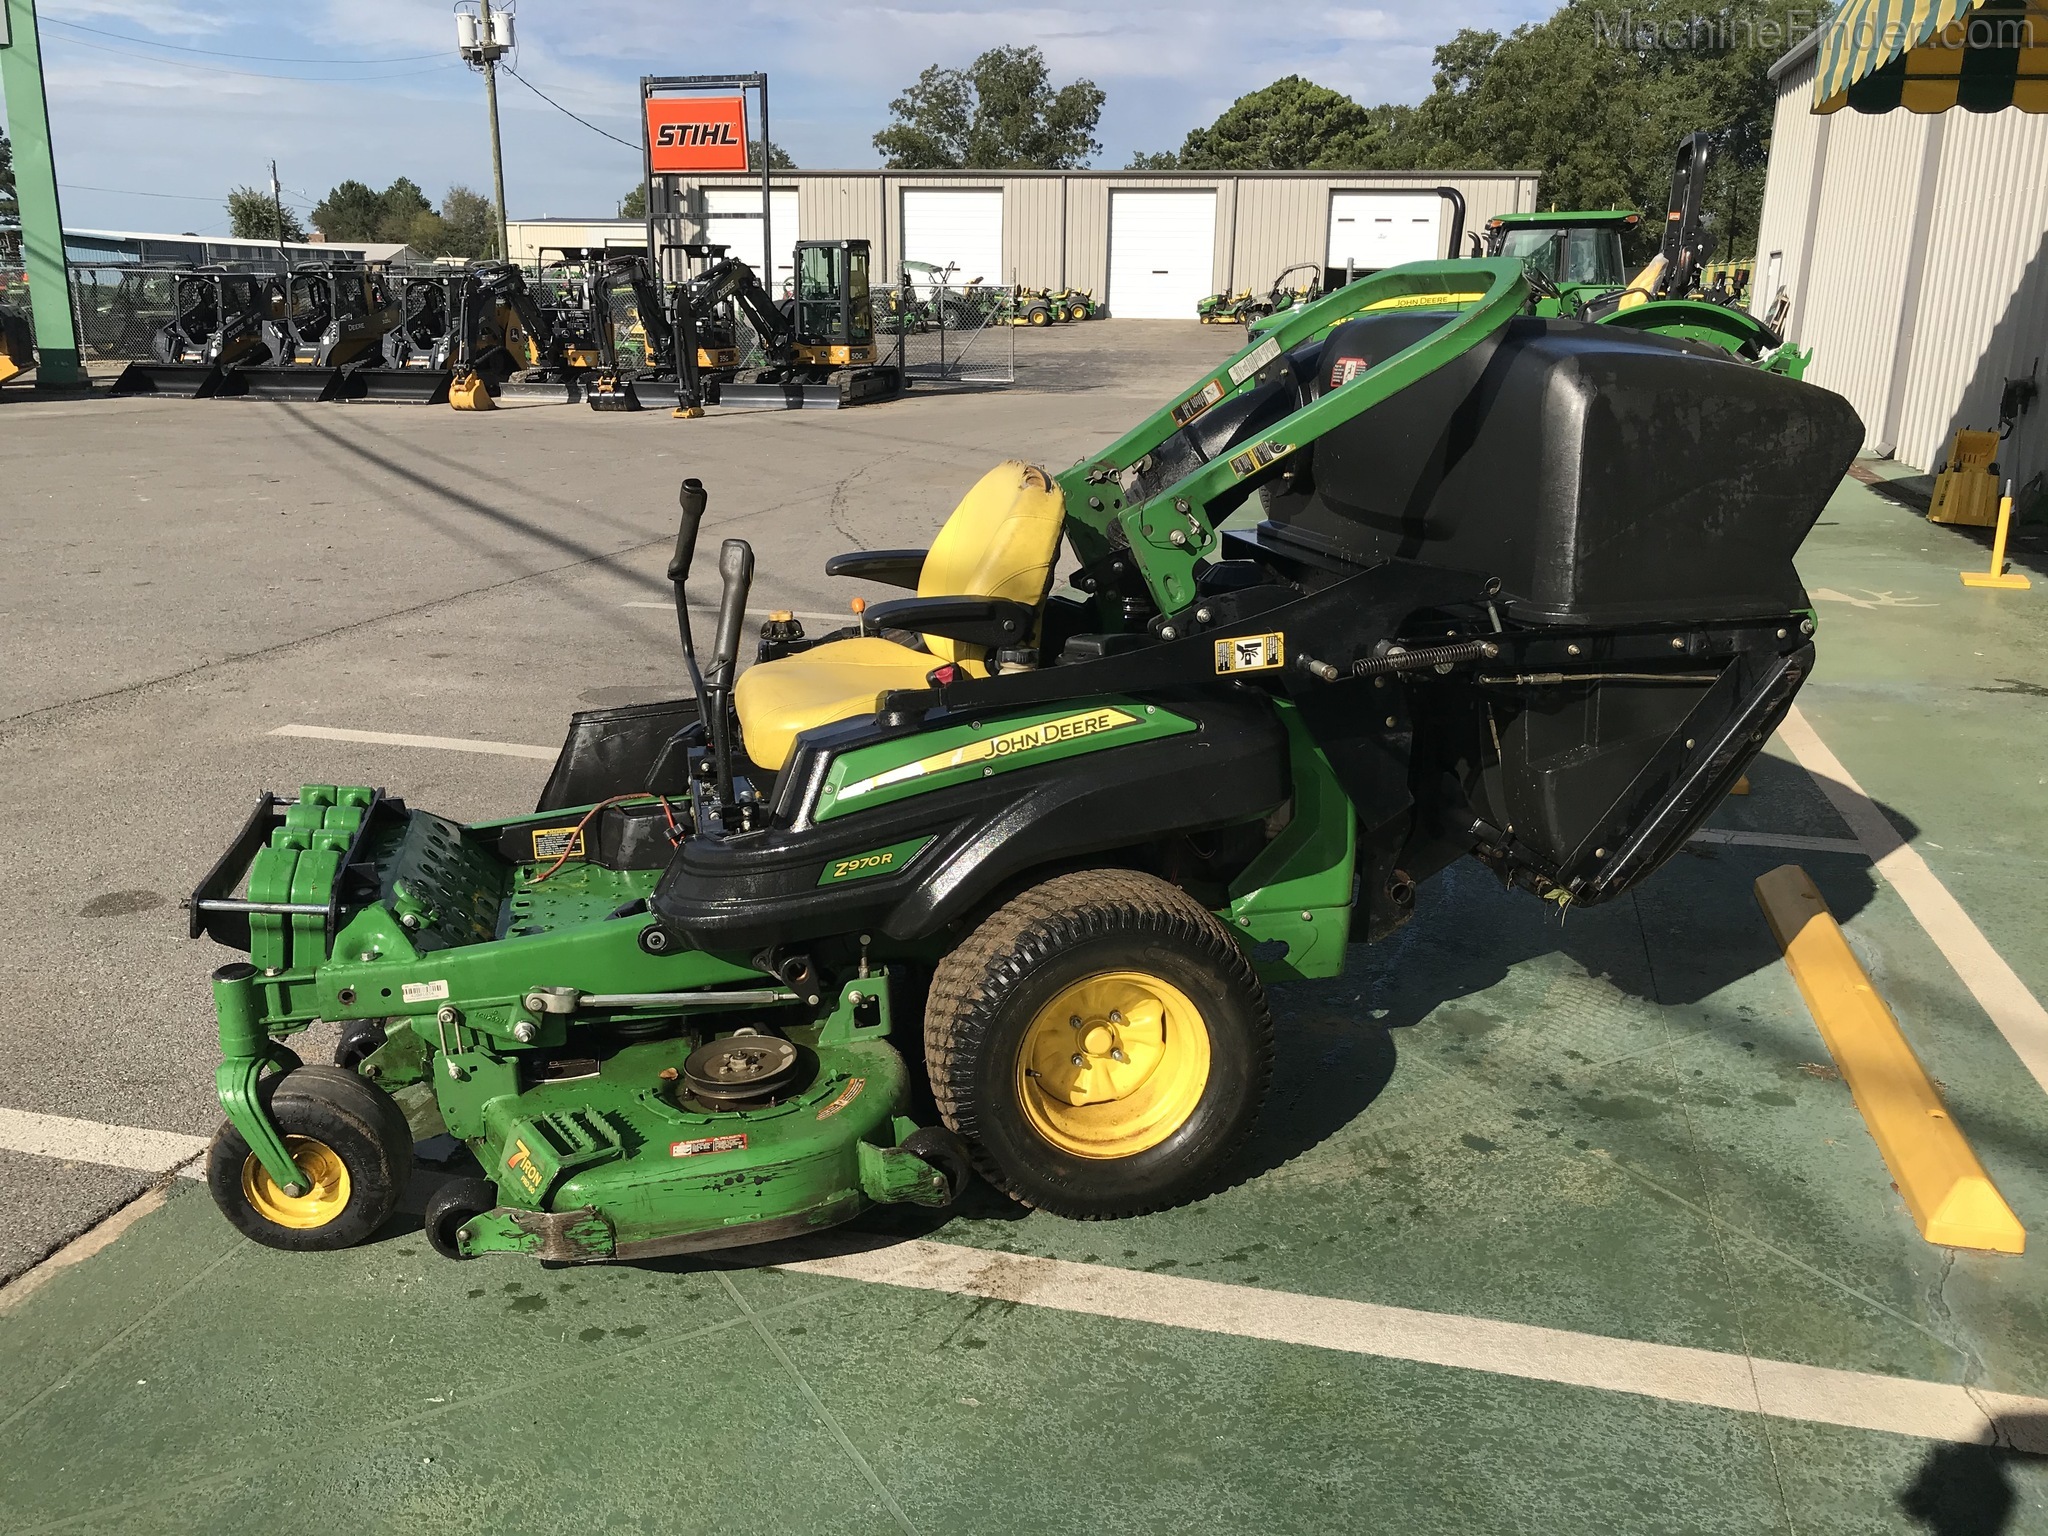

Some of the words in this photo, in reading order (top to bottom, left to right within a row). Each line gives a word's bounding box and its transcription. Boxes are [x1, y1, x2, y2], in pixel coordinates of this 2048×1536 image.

[656, 123, 738, 147] STIHL
[716, 279, 736, 299] DEERE
[1395, 299, 1419, 307] JOHN
[1420, 296, 1448, 305] DEERE
[227, 323, 245, 339] DEERE
[348, 322, 366, 332] DEERE
[984, 730, 1040, 759] JOHN
[1043, 714, 1111, 744] DEERE
[519, 1156, 543, 1187] IRON
